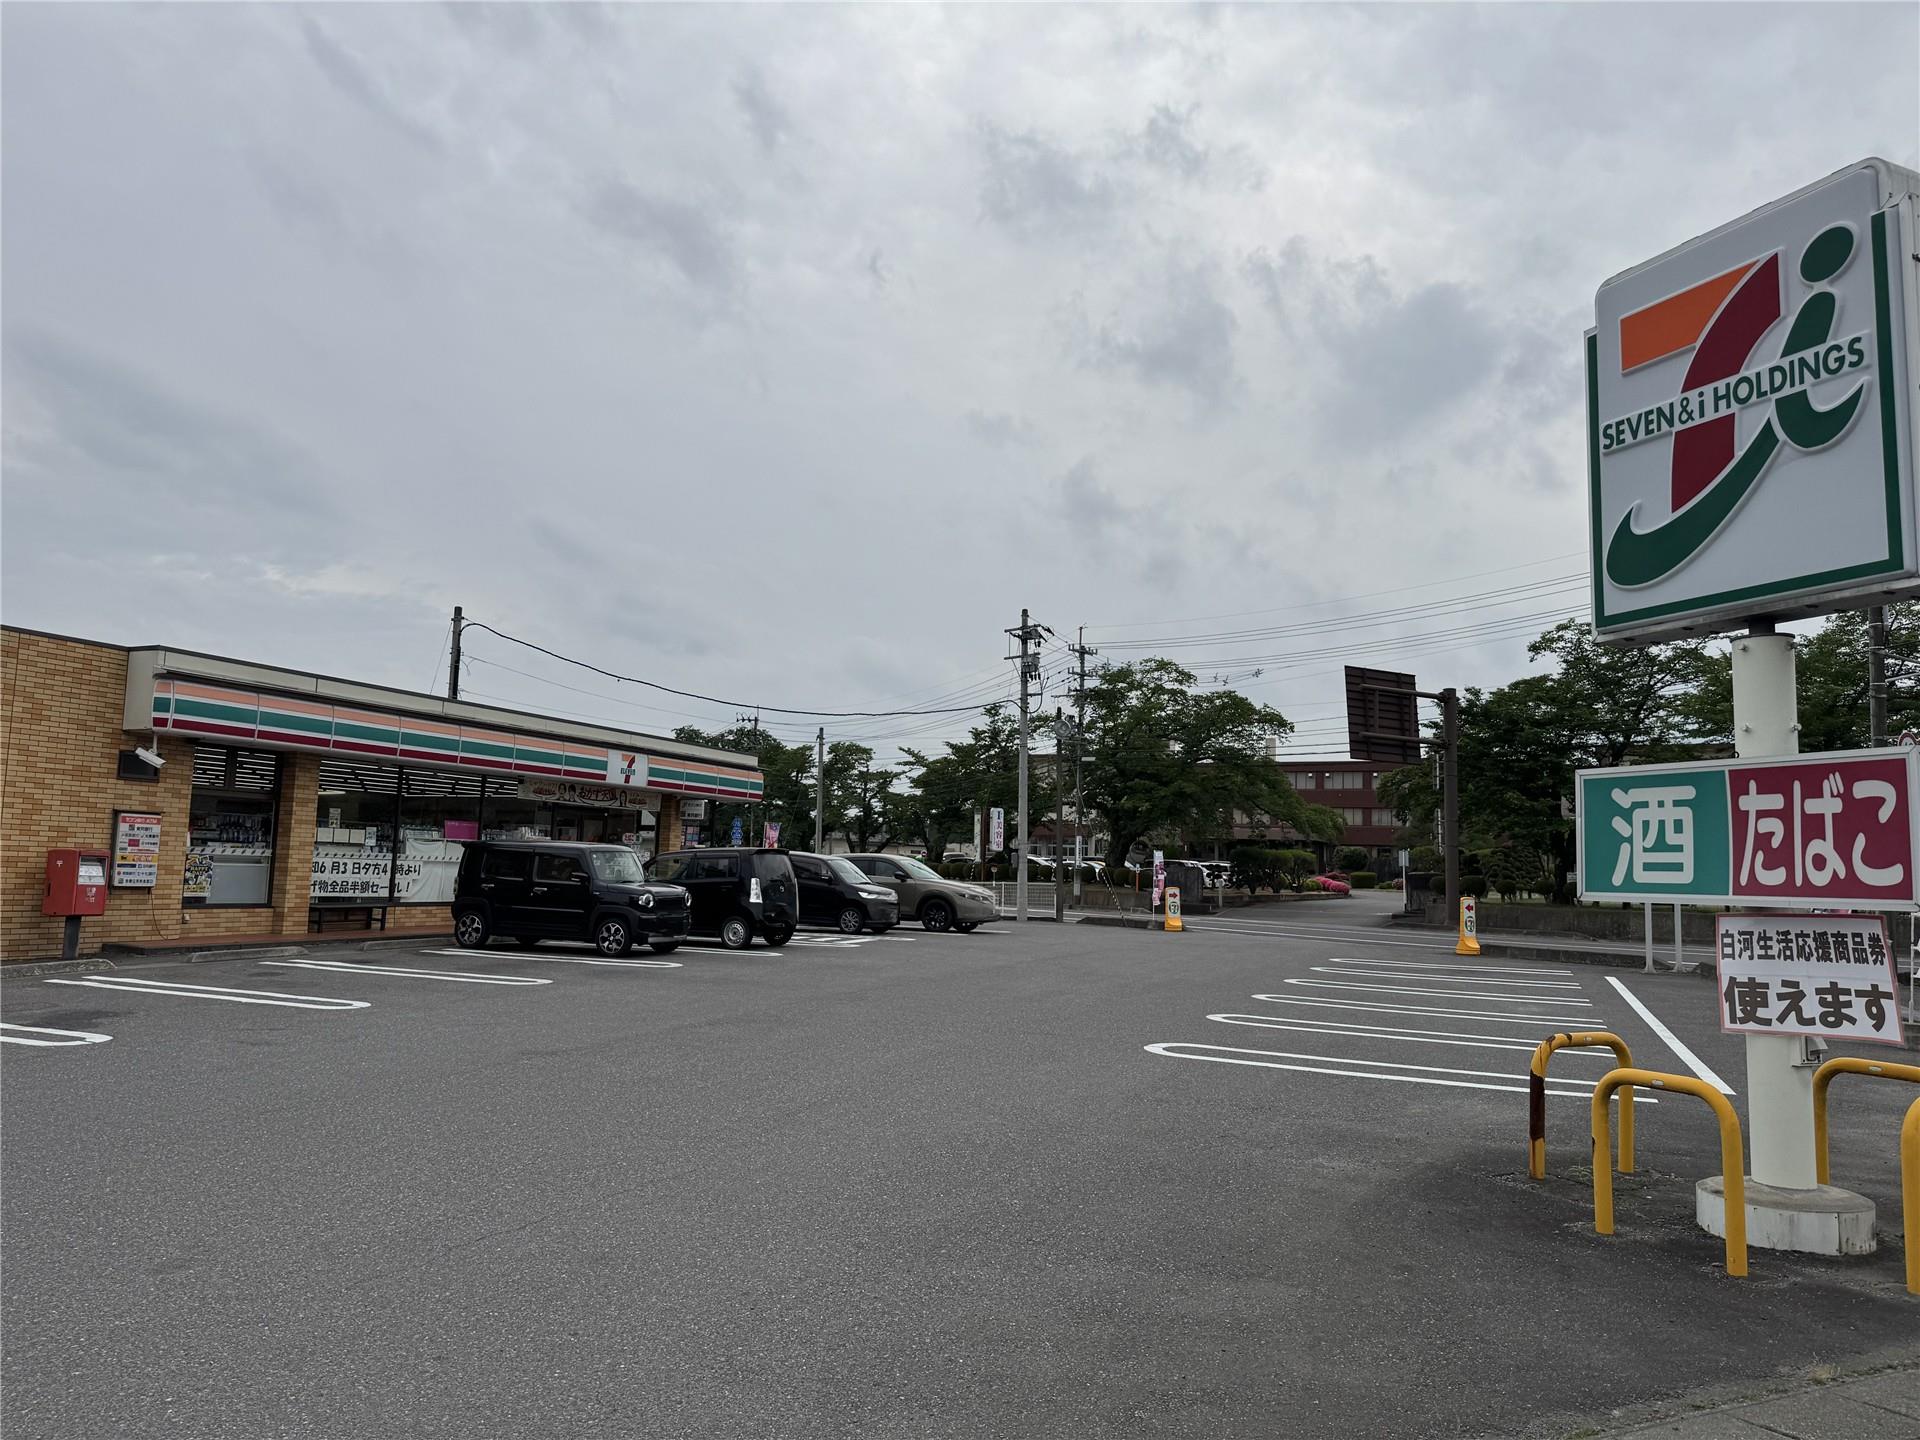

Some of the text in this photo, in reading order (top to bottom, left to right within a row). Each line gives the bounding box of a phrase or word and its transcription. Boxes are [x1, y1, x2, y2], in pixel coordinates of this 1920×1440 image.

[1712, 336, 1865, 413] HOLDINGS
[1610, 785, 1697, 887] 酒
[1737, 770, 1905, 888] たばこ
[1720, 928, 1888, 967] 白河生活応援商品券
[1723, 976, 1894, 1033] 使えます
